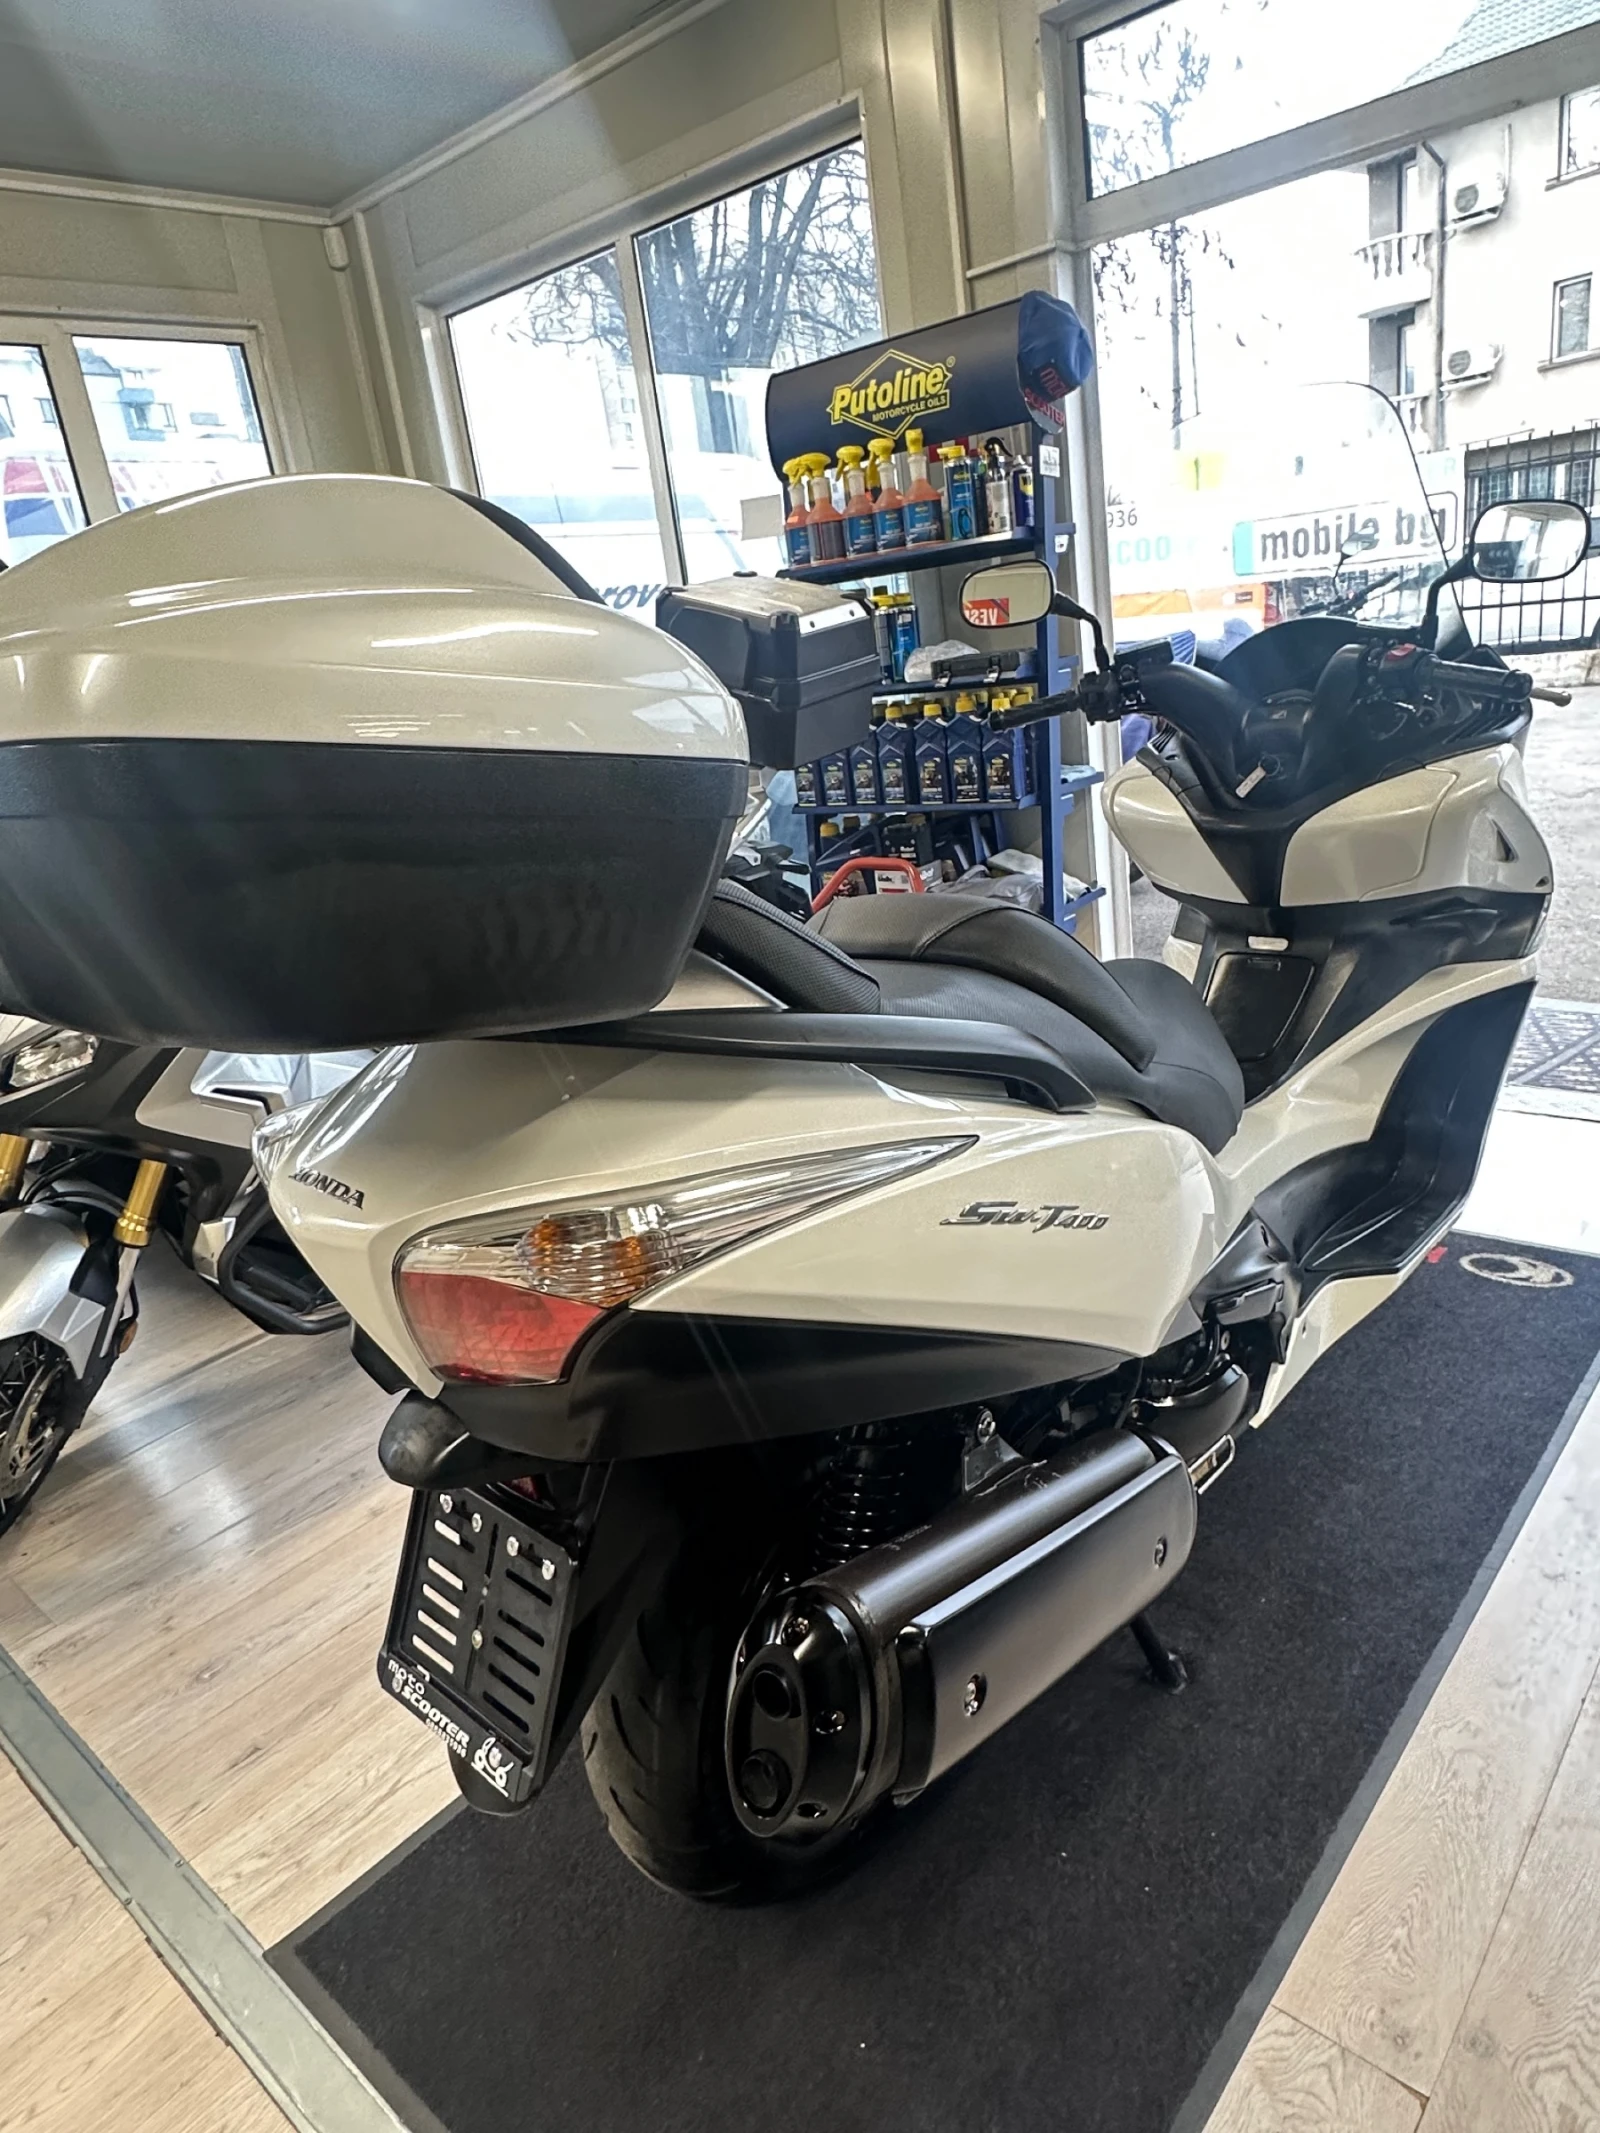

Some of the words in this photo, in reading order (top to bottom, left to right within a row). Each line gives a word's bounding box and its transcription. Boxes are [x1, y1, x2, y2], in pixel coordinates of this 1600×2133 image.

[833, 366, 945, 421] Putoline
[871, 400, 926, 422] MOTORCYCLE
[926, 394, 947, 408] OILS
[1260, 512, 1380, 562] mobile
[287, 1167, 366, 1212] HONDA
[387, 1659, 426, 1696] moto
[401, 1684, 471, 1749] SCOOTER
